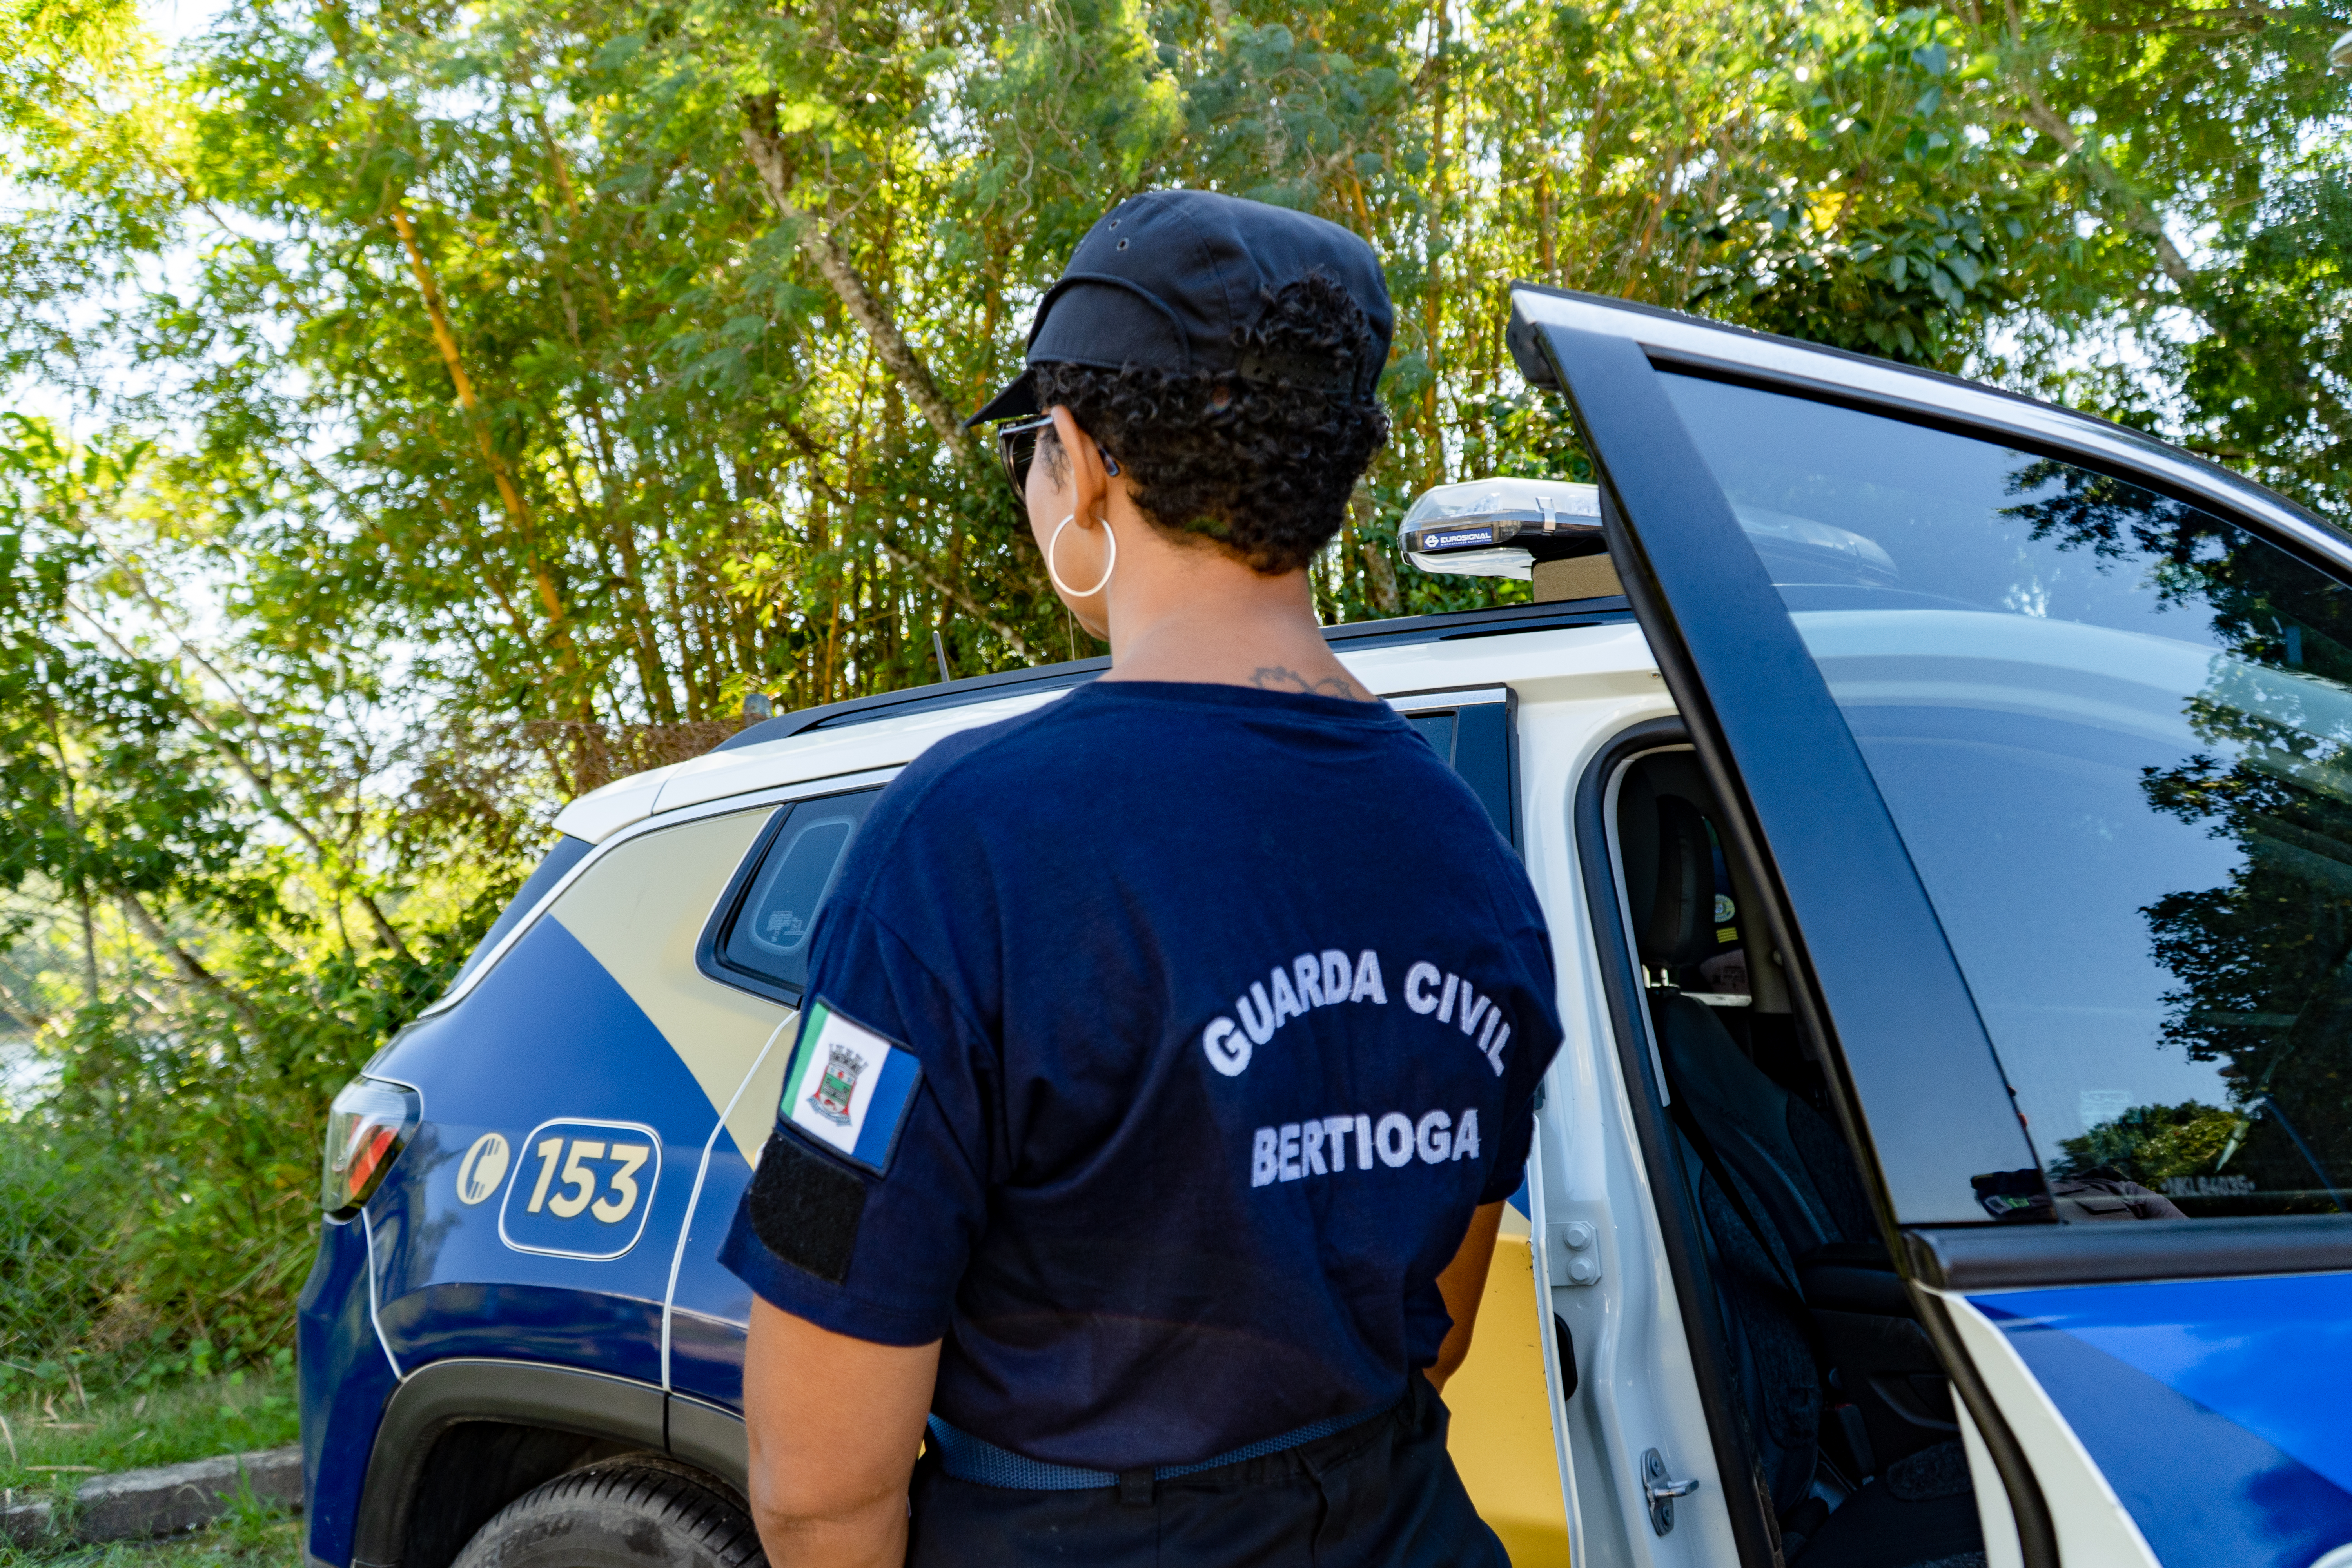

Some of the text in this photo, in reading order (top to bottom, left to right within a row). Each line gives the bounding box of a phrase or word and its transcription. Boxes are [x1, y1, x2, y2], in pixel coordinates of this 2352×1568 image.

[1441, 533, 1491, 543] EUROSIGNAL
[1203, 949, 1511, 1077] GUARDA CIVIL
[527, 1138, 649, 1224] 153
[1251, 1108, 1480, 1187] BERTIOGA
